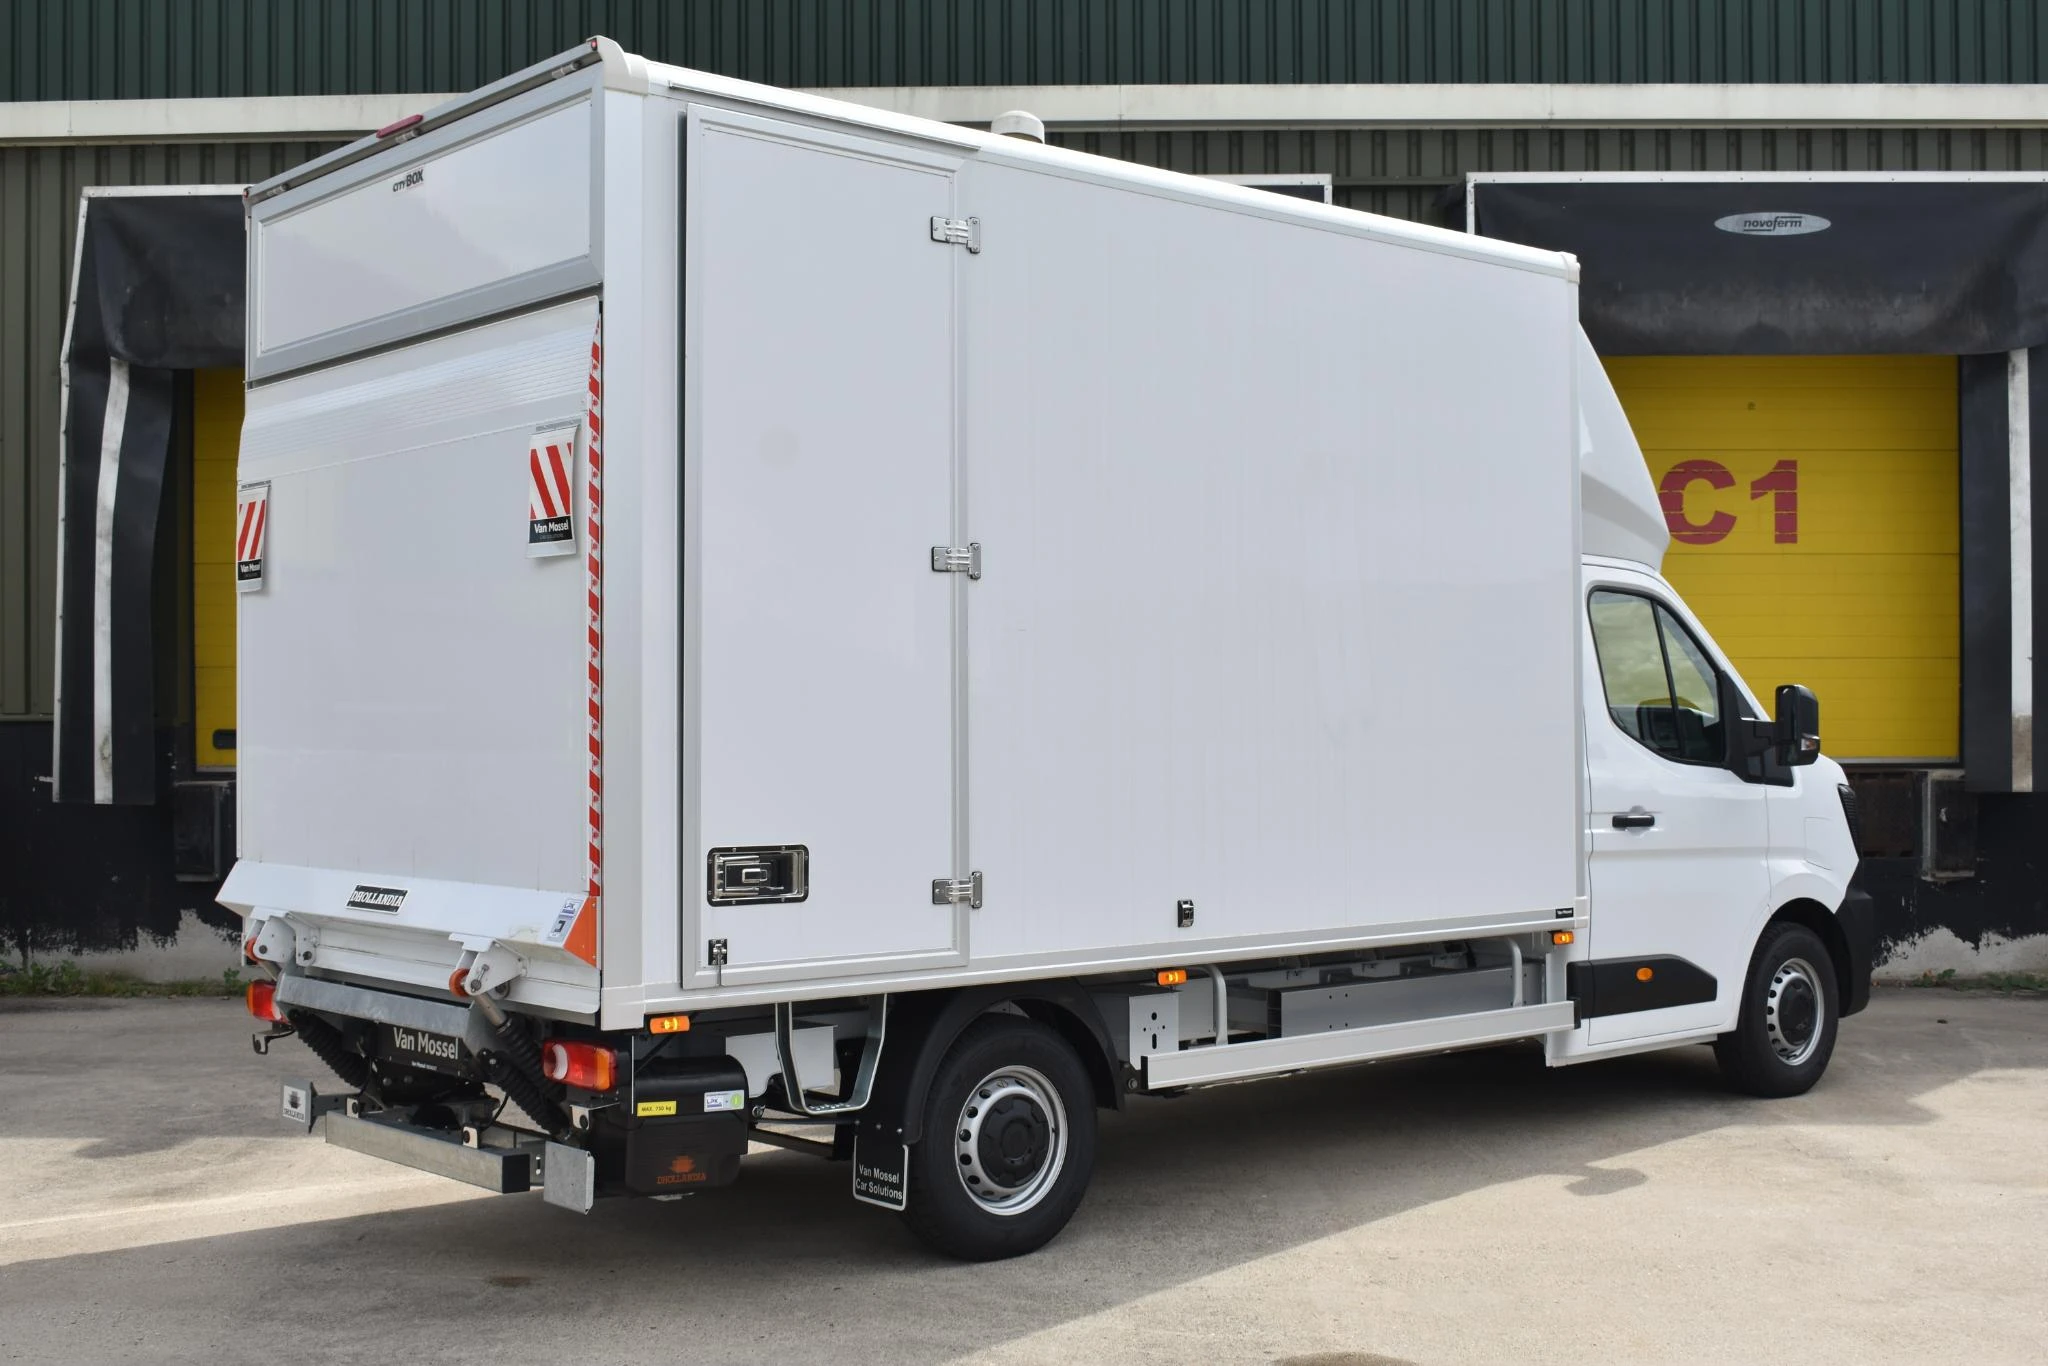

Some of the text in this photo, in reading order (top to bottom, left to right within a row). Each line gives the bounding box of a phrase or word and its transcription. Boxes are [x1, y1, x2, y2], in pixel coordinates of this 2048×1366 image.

[1743, 216, 1803, 232] novoferm
[1658, 459, 1798, 545] C1
[534, 519, 569, 534] Van Mossel
[350, 890, 404, 907] DHOLLANDIA
[393, 1026, 459, 1060] Van Mossel
[859, 1163, 900, 1184] Van Mossel
[855, 1178, 903, 1200] Car Solutions
